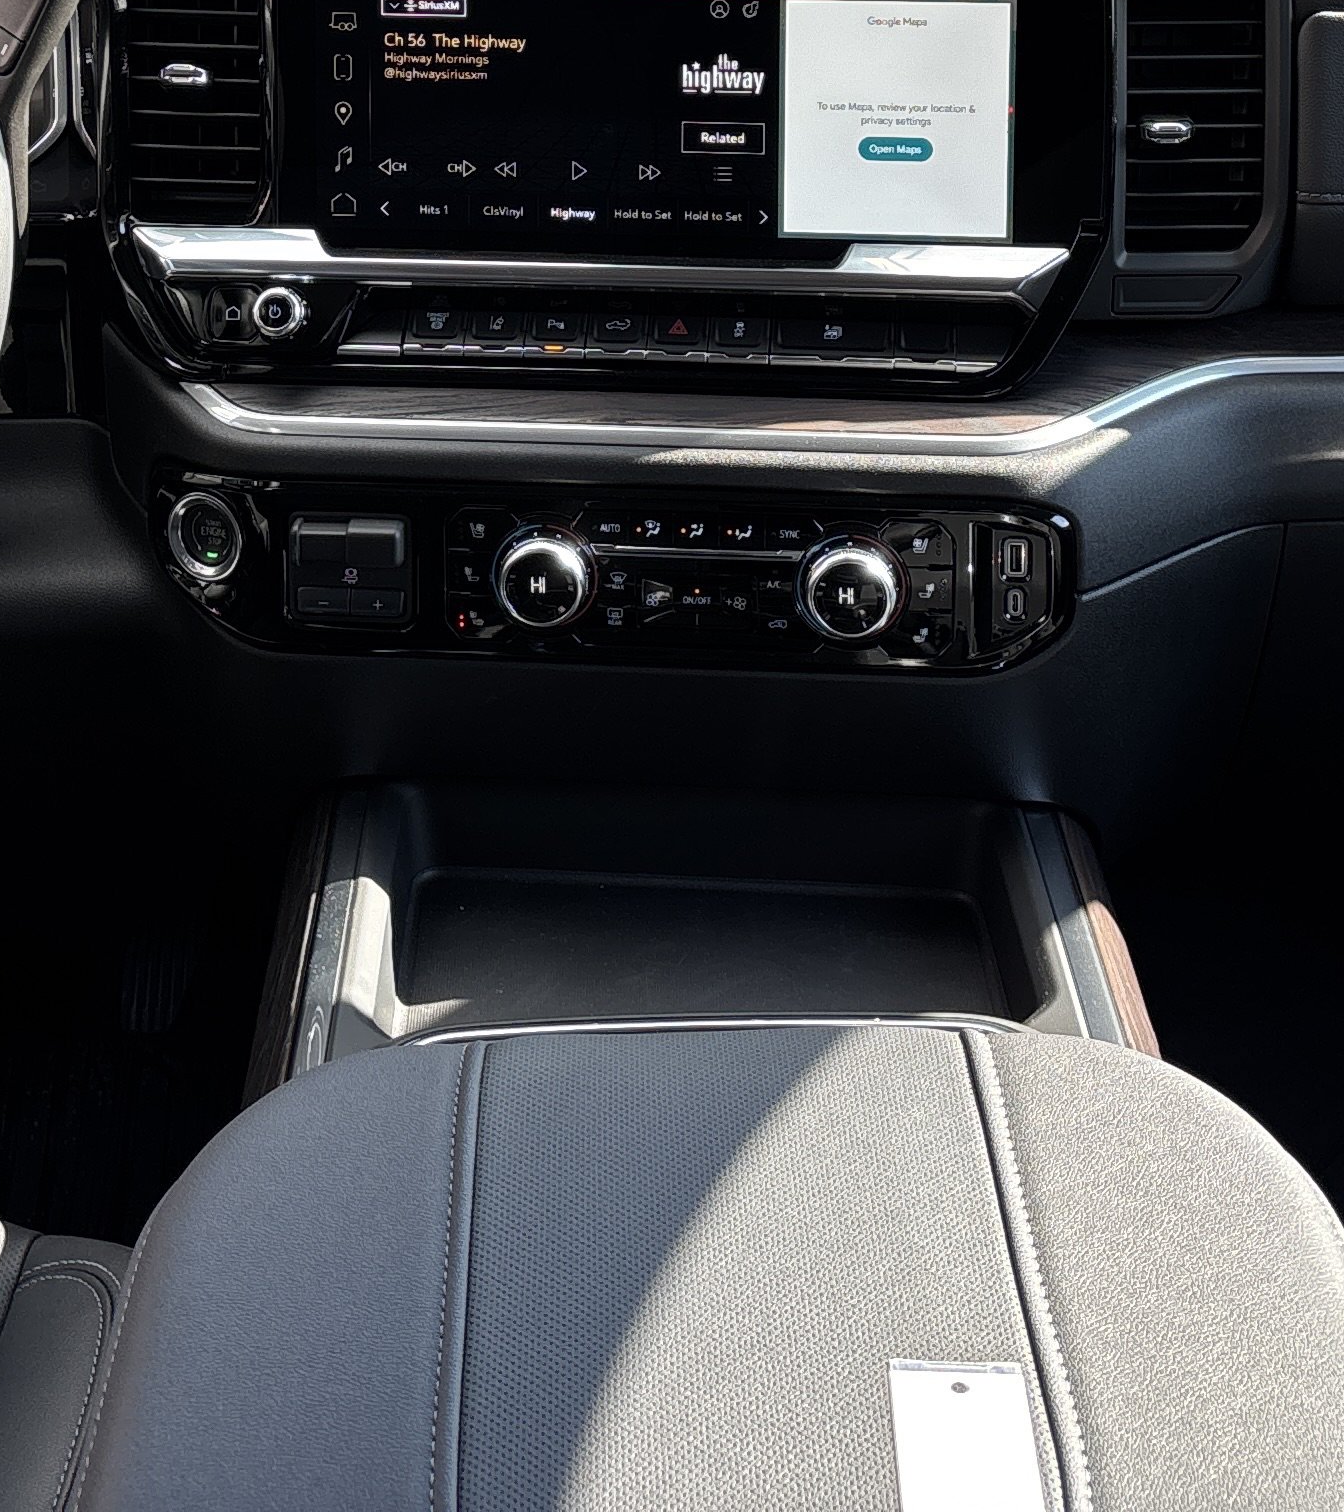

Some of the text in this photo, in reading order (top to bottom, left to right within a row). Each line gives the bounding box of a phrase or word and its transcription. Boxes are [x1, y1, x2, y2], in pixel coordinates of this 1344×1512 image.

[418, 0, 460, 10] SiriusXM
[867, 16, 901, 28] Google
[384, 32, 526, 53] Ch 56 The Highway
[384, 52, 490, 67] Highway Mornings
[718, 53, 739, 70] the
[384, 67, 488, 82] @highwaysiriusxm
[682, 63, 765, 95] highway
[817, 101, 828, 111] To
[830, 102, 847, 111] use
[877, 103, 906, 112] review
[908, 104, 928, 114] your
[931, 103, 967, 113] location
[969, 104, 976, 113] &
[860, 116, 931, 128] privacy settings
[700, 131, 745, 144] Related
[869, 144, 922, 155] Open Maps
[419, 204, 449, 215] Hits 1
[483, 206, 524, 219] ClsVinyl
[550, 207, 596, 221] Highway
[613, 208, 672, 220] Hold to Set
[684, 210, 743, 222] Hold to Set
[599, 523, 621, 533] AUTO
[779, 529, 800, 539] SYNC
[766, 580, 782, 589] A/C
[682, 595, 712, 605] ON/OFF
